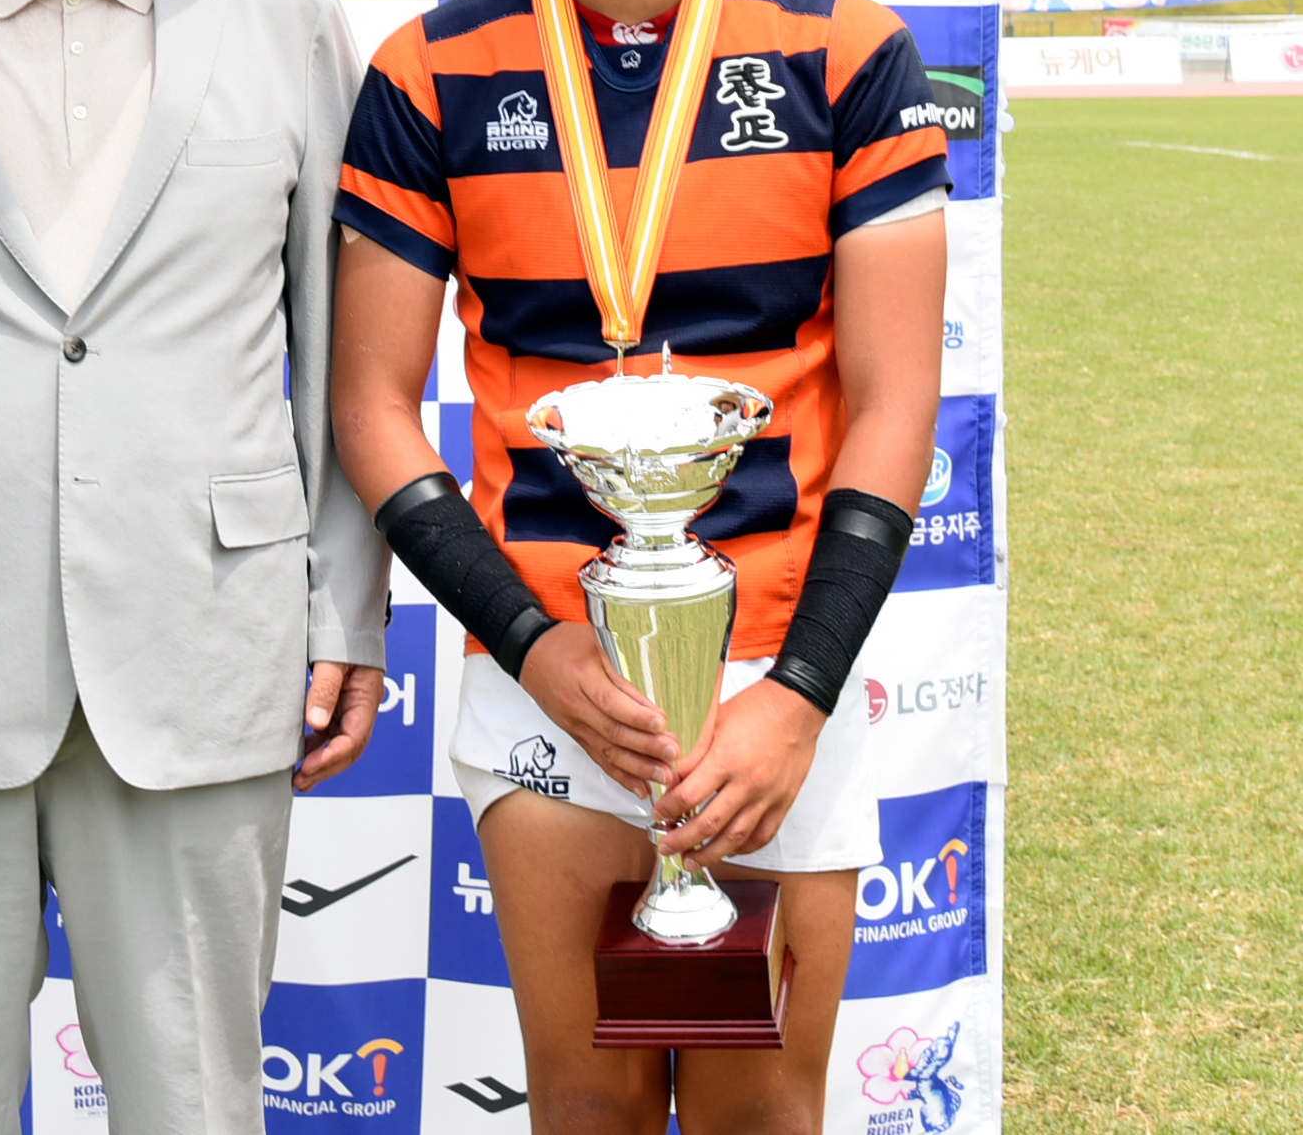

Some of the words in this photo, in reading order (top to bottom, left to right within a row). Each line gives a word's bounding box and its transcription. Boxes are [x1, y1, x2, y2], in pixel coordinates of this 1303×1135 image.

[1040, 47, 1124, 76] 뉴케어
[486, 124, 549, 137] RHINO
[486, 139, 549, 152] RUGBY
[854, 918, 927, 944] FINANCIAL
[928, 907, 969, 933] GROUP
[263, 1093, 338, 1117] INANCIAL
[341, 1099, 397, 1117] GROUP
[868, 1108, 915, 1126] KOREA
